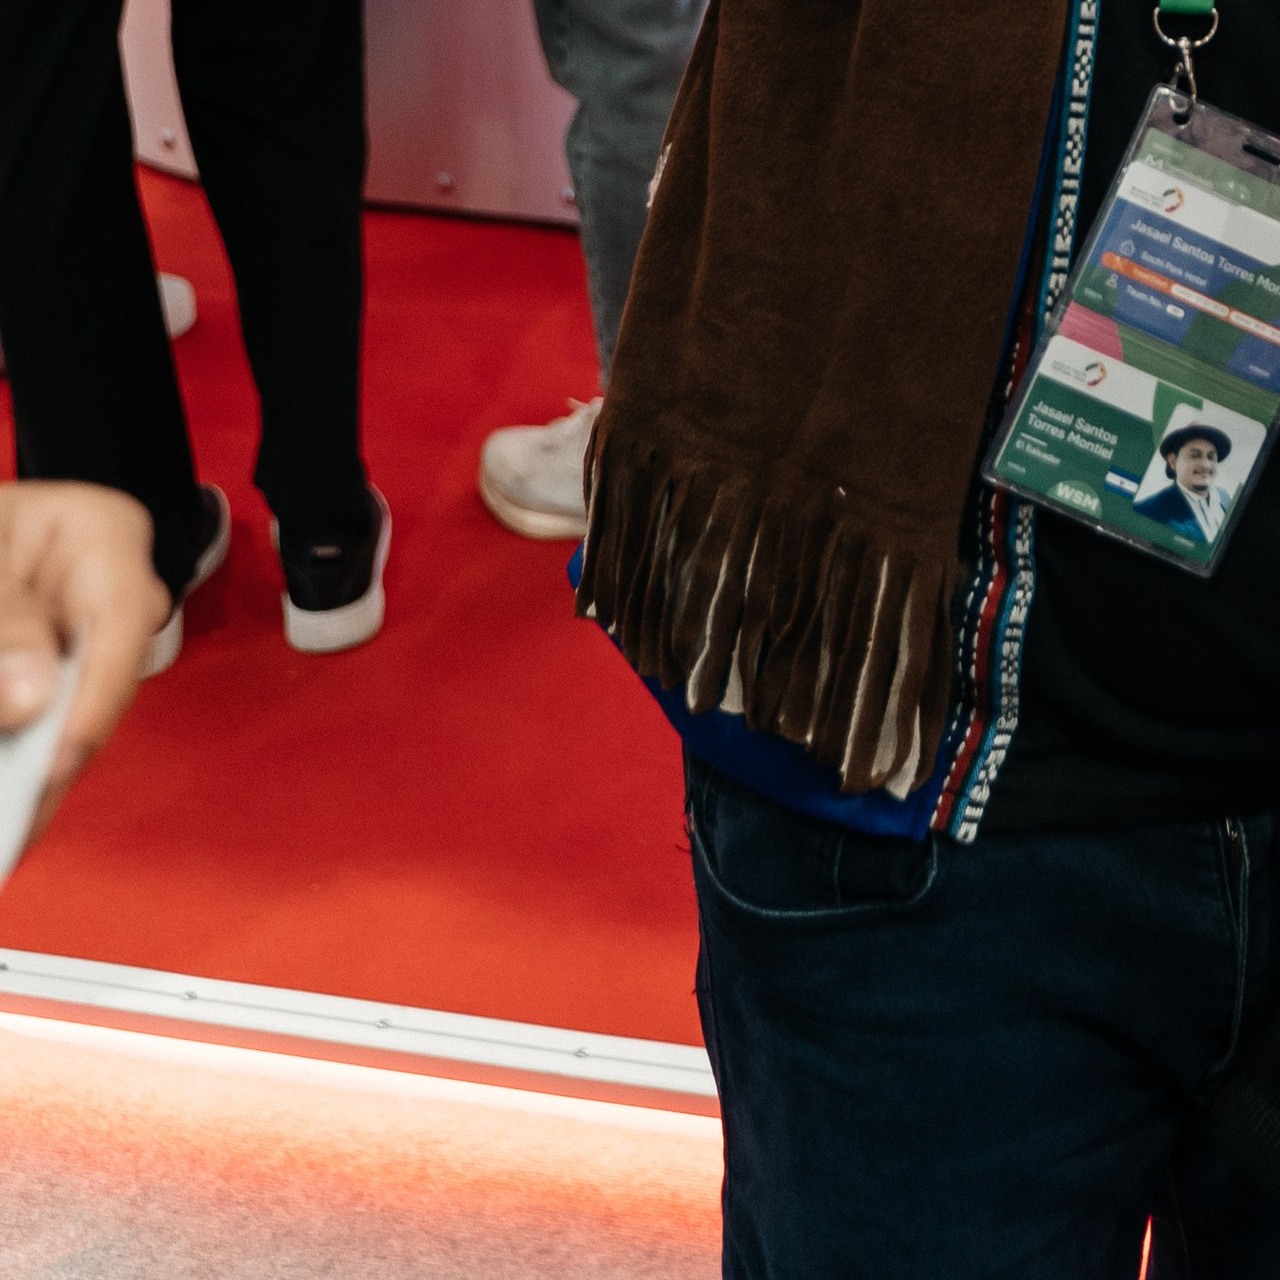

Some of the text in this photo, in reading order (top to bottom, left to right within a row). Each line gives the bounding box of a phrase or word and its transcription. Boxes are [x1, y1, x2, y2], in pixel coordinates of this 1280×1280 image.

[1170, 235, 1217, 265] Santos
[1216, 255, 1257, 283] Torres
[1025, 412, 1114, 461] Torres Montiel
[1032, 398, 1120, 446] Jasael Santos
[1054, 481, 1100, 512] WSM
